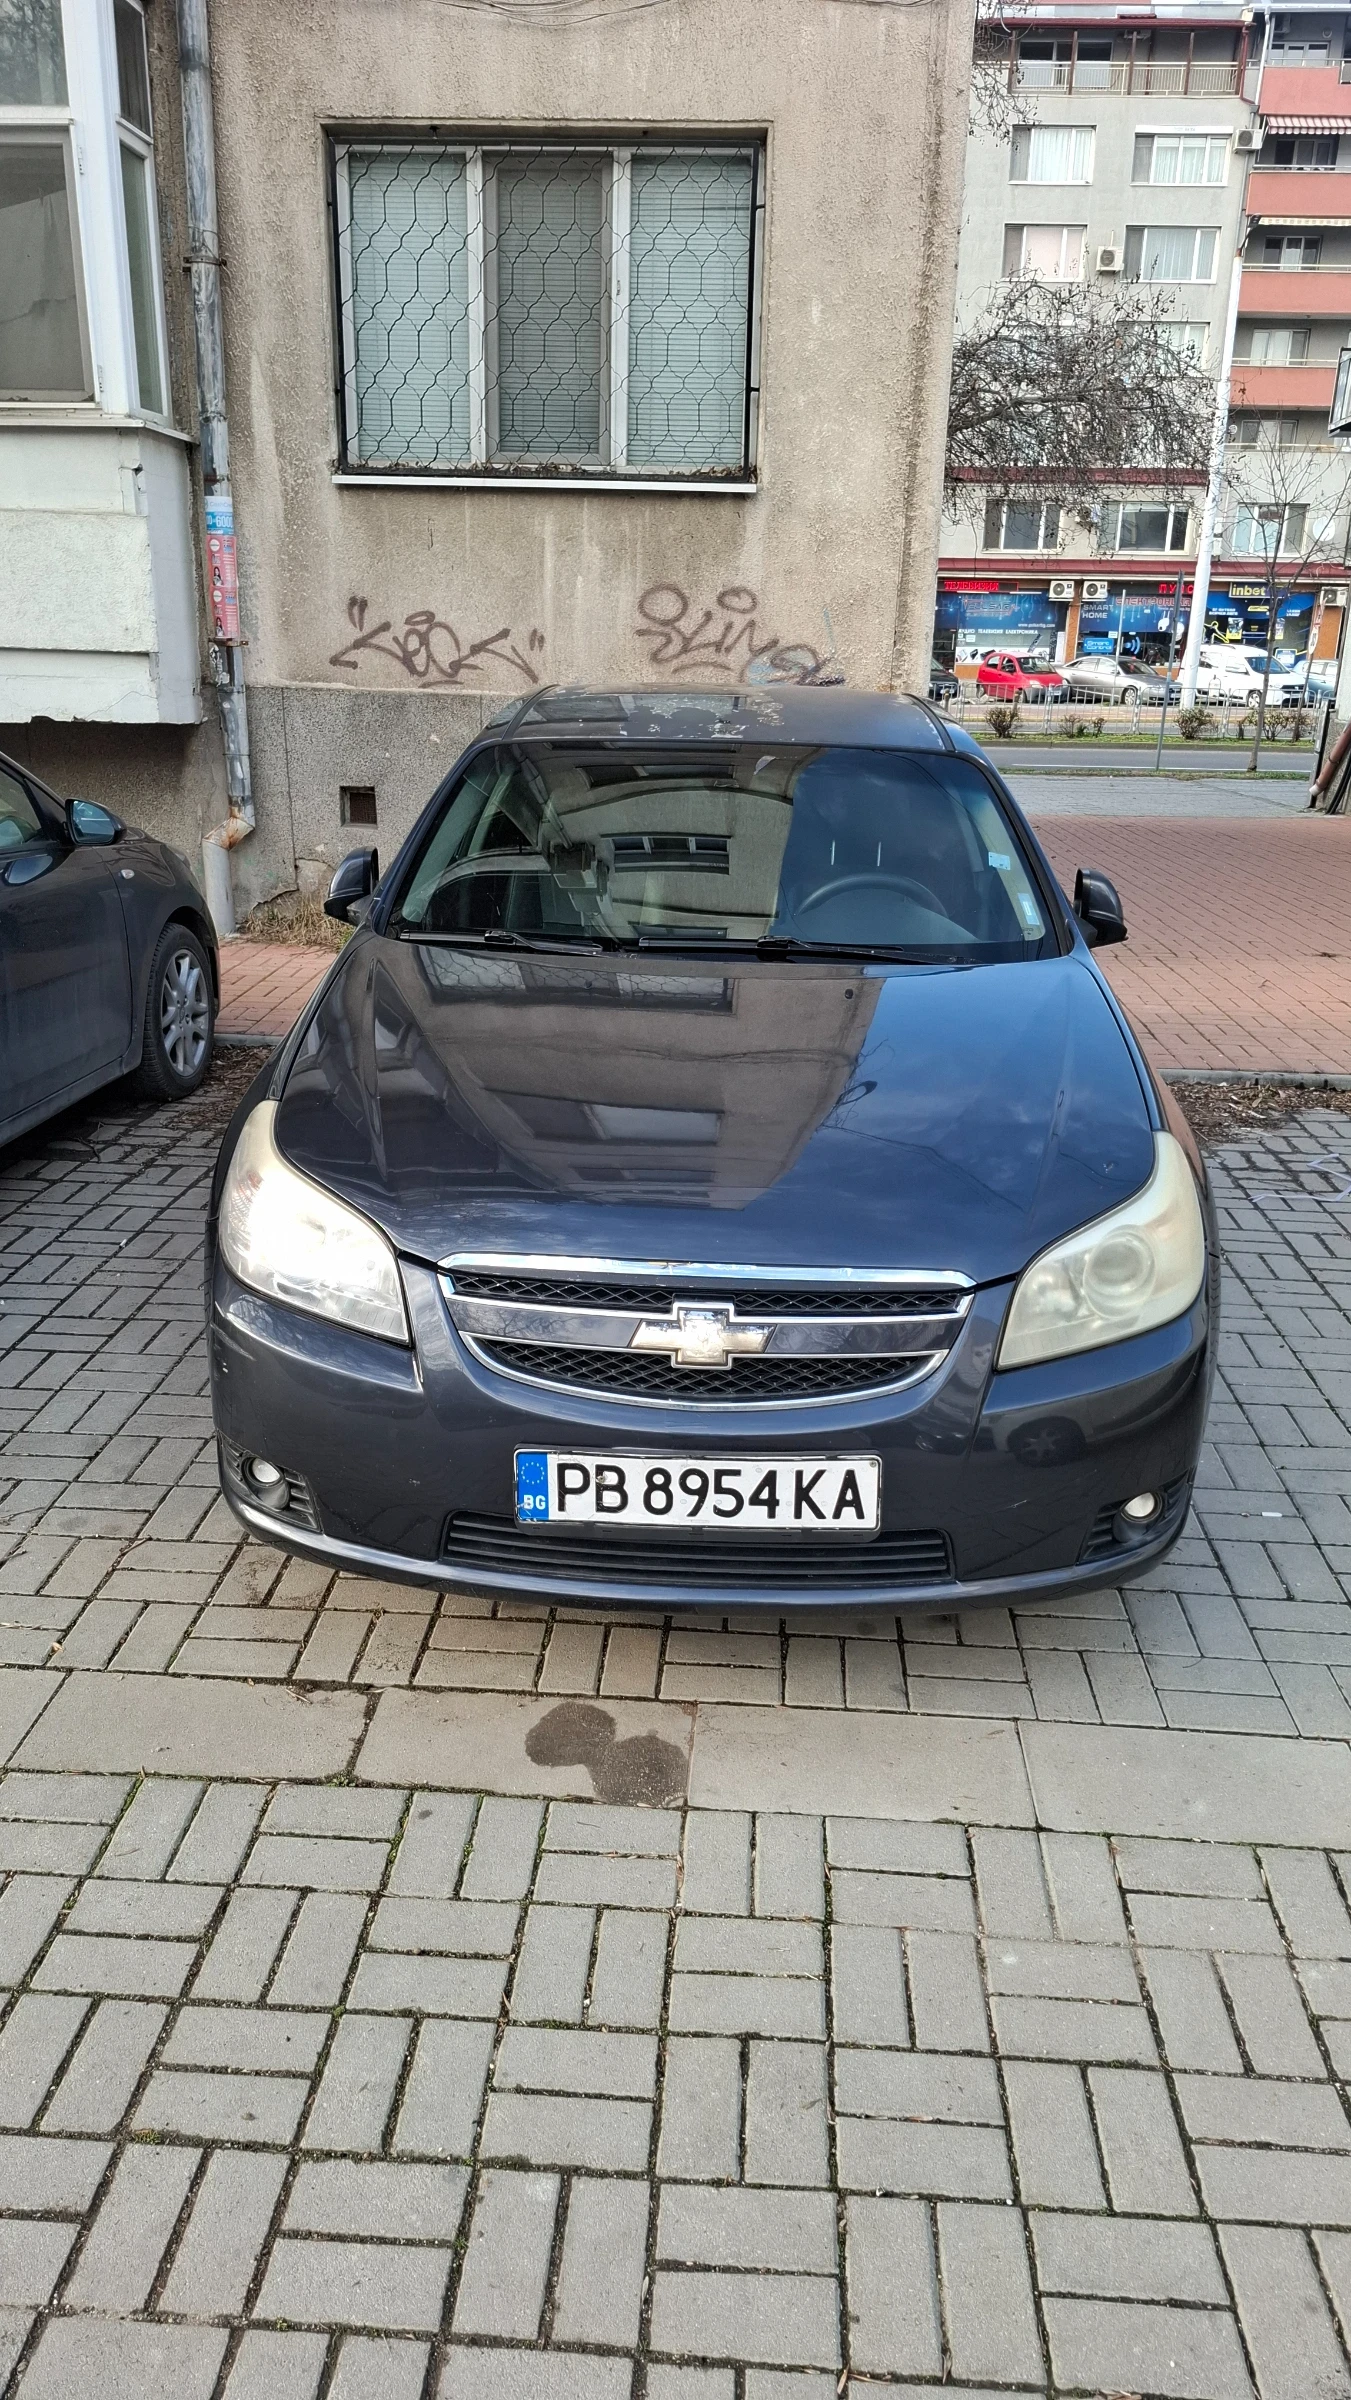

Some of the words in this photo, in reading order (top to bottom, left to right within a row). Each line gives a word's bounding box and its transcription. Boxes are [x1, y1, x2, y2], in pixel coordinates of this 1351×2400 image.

[1232, 584, 1266, 596] inbet
[1083, 604, 1114, 612] SMART
[557, 1462, 629, 1513] PB
[643, 1467, 780, 1519] 8954
[793, 1469, 866, 1520] KA
[523, 1494, 546, 1510] BG
